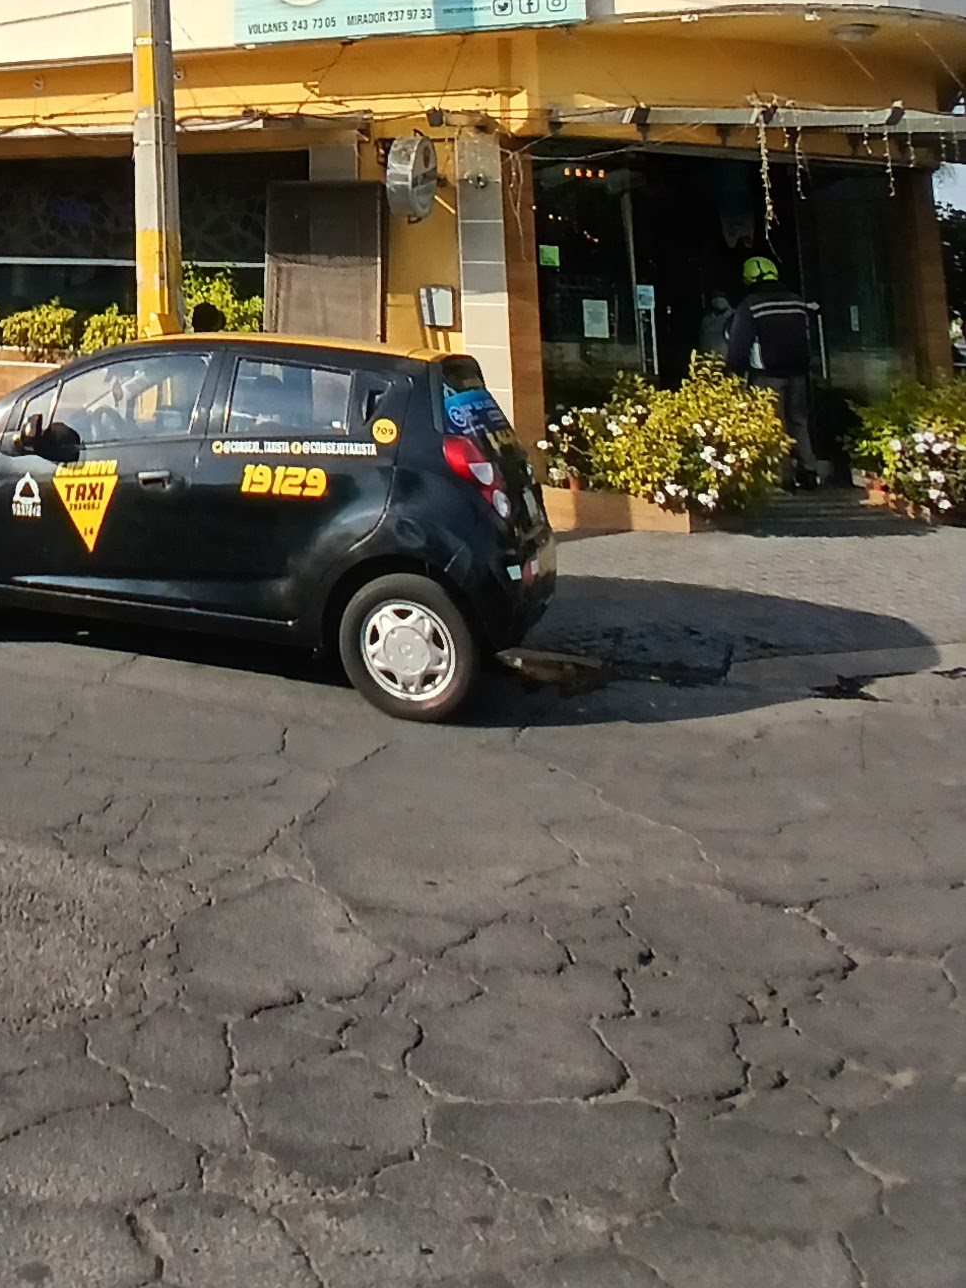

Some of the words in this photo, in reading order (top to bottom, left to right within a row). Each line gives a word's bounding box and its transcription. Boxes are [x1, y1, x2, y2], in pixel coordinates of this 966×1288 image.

[248, 21, 288, 35] VOLCANES
[292, 19, 308, 31] 243
[325, 16, 336, 28] 05
[347, 12, 385, 26] MIRADOR
[388, 10, 404, 22] 237
[407, 9, 418, 20] 97
[420, 8, 432, 19] 33
[241, 463, 328, 498] 19129
[65, 482, 105, 502] TAXI
